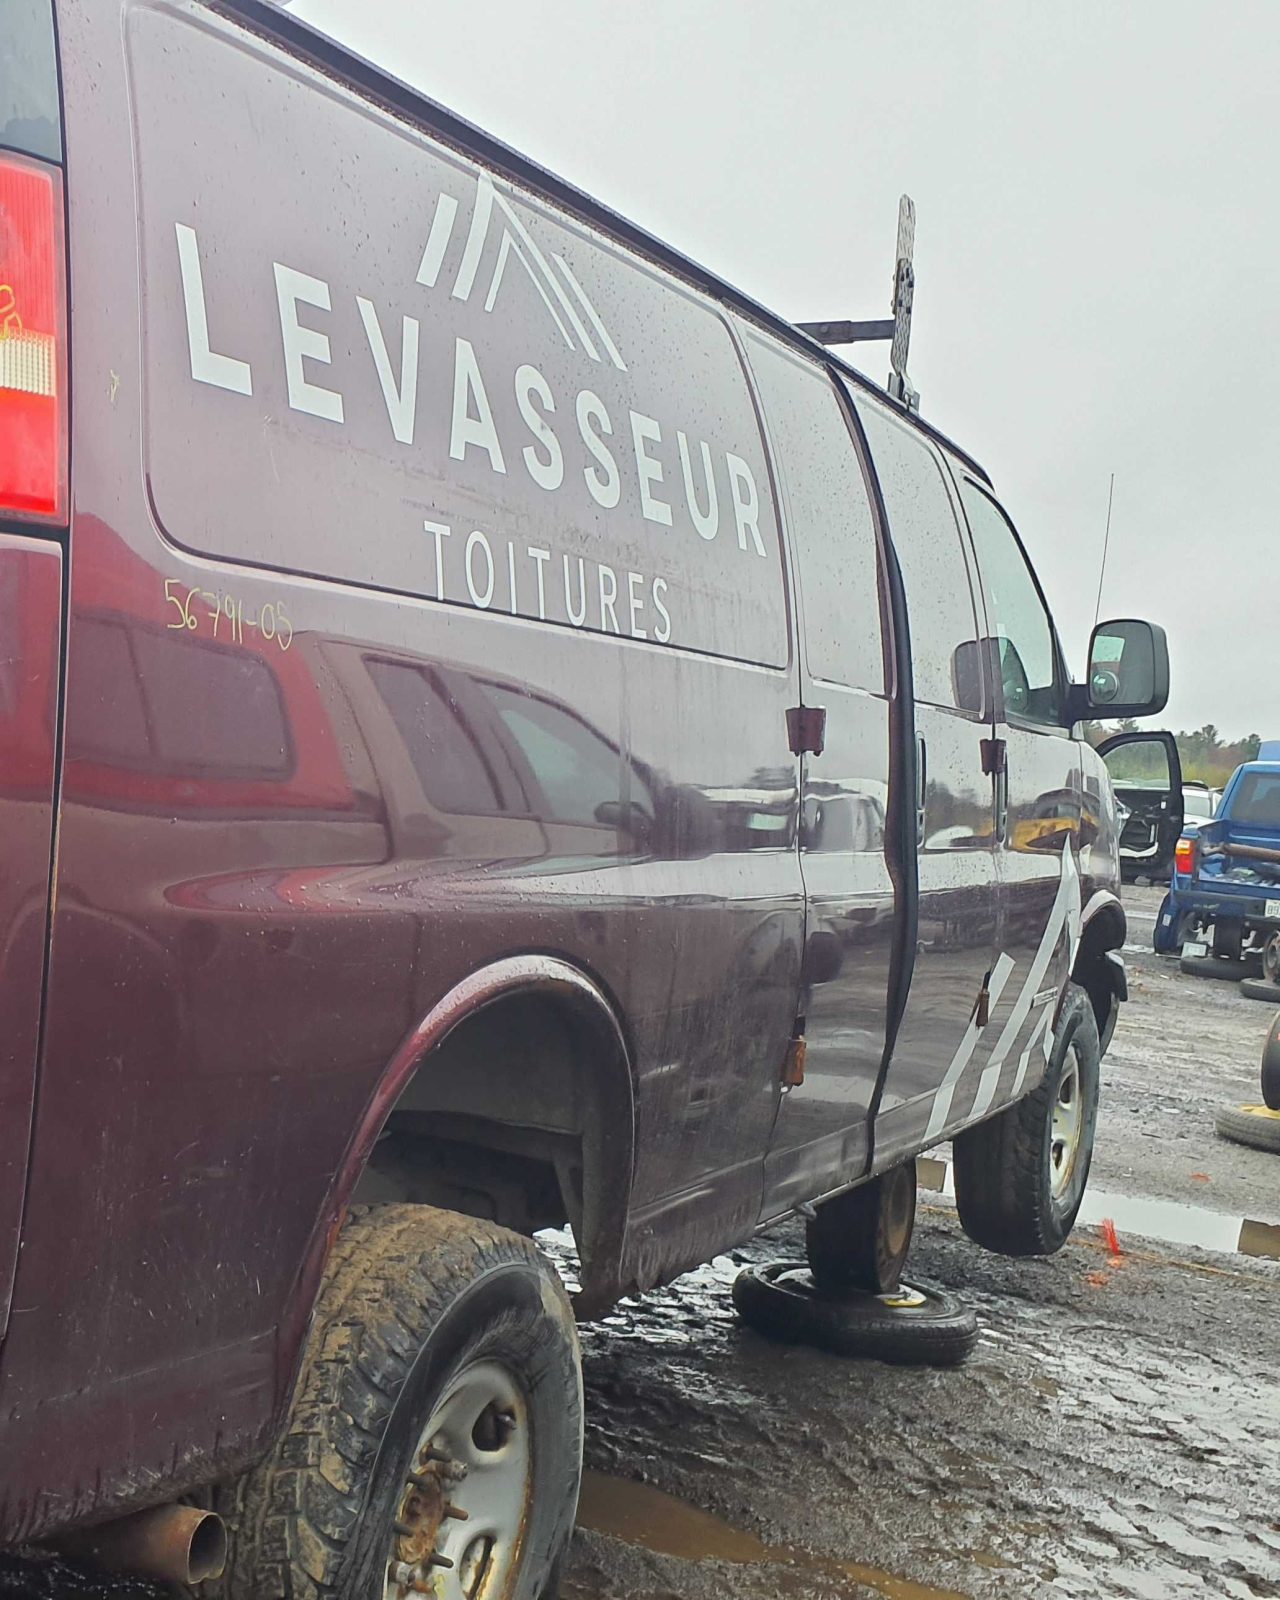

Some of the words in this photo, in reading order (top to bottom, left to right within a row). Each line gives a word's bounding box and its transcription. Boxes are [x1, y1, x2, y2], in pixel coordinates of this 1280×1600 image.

[175, 222, 768, 558] LEVASSEUR
[164, 579, 293, 651] 56791-05
[424, 520, 672, 643] TOITURES
